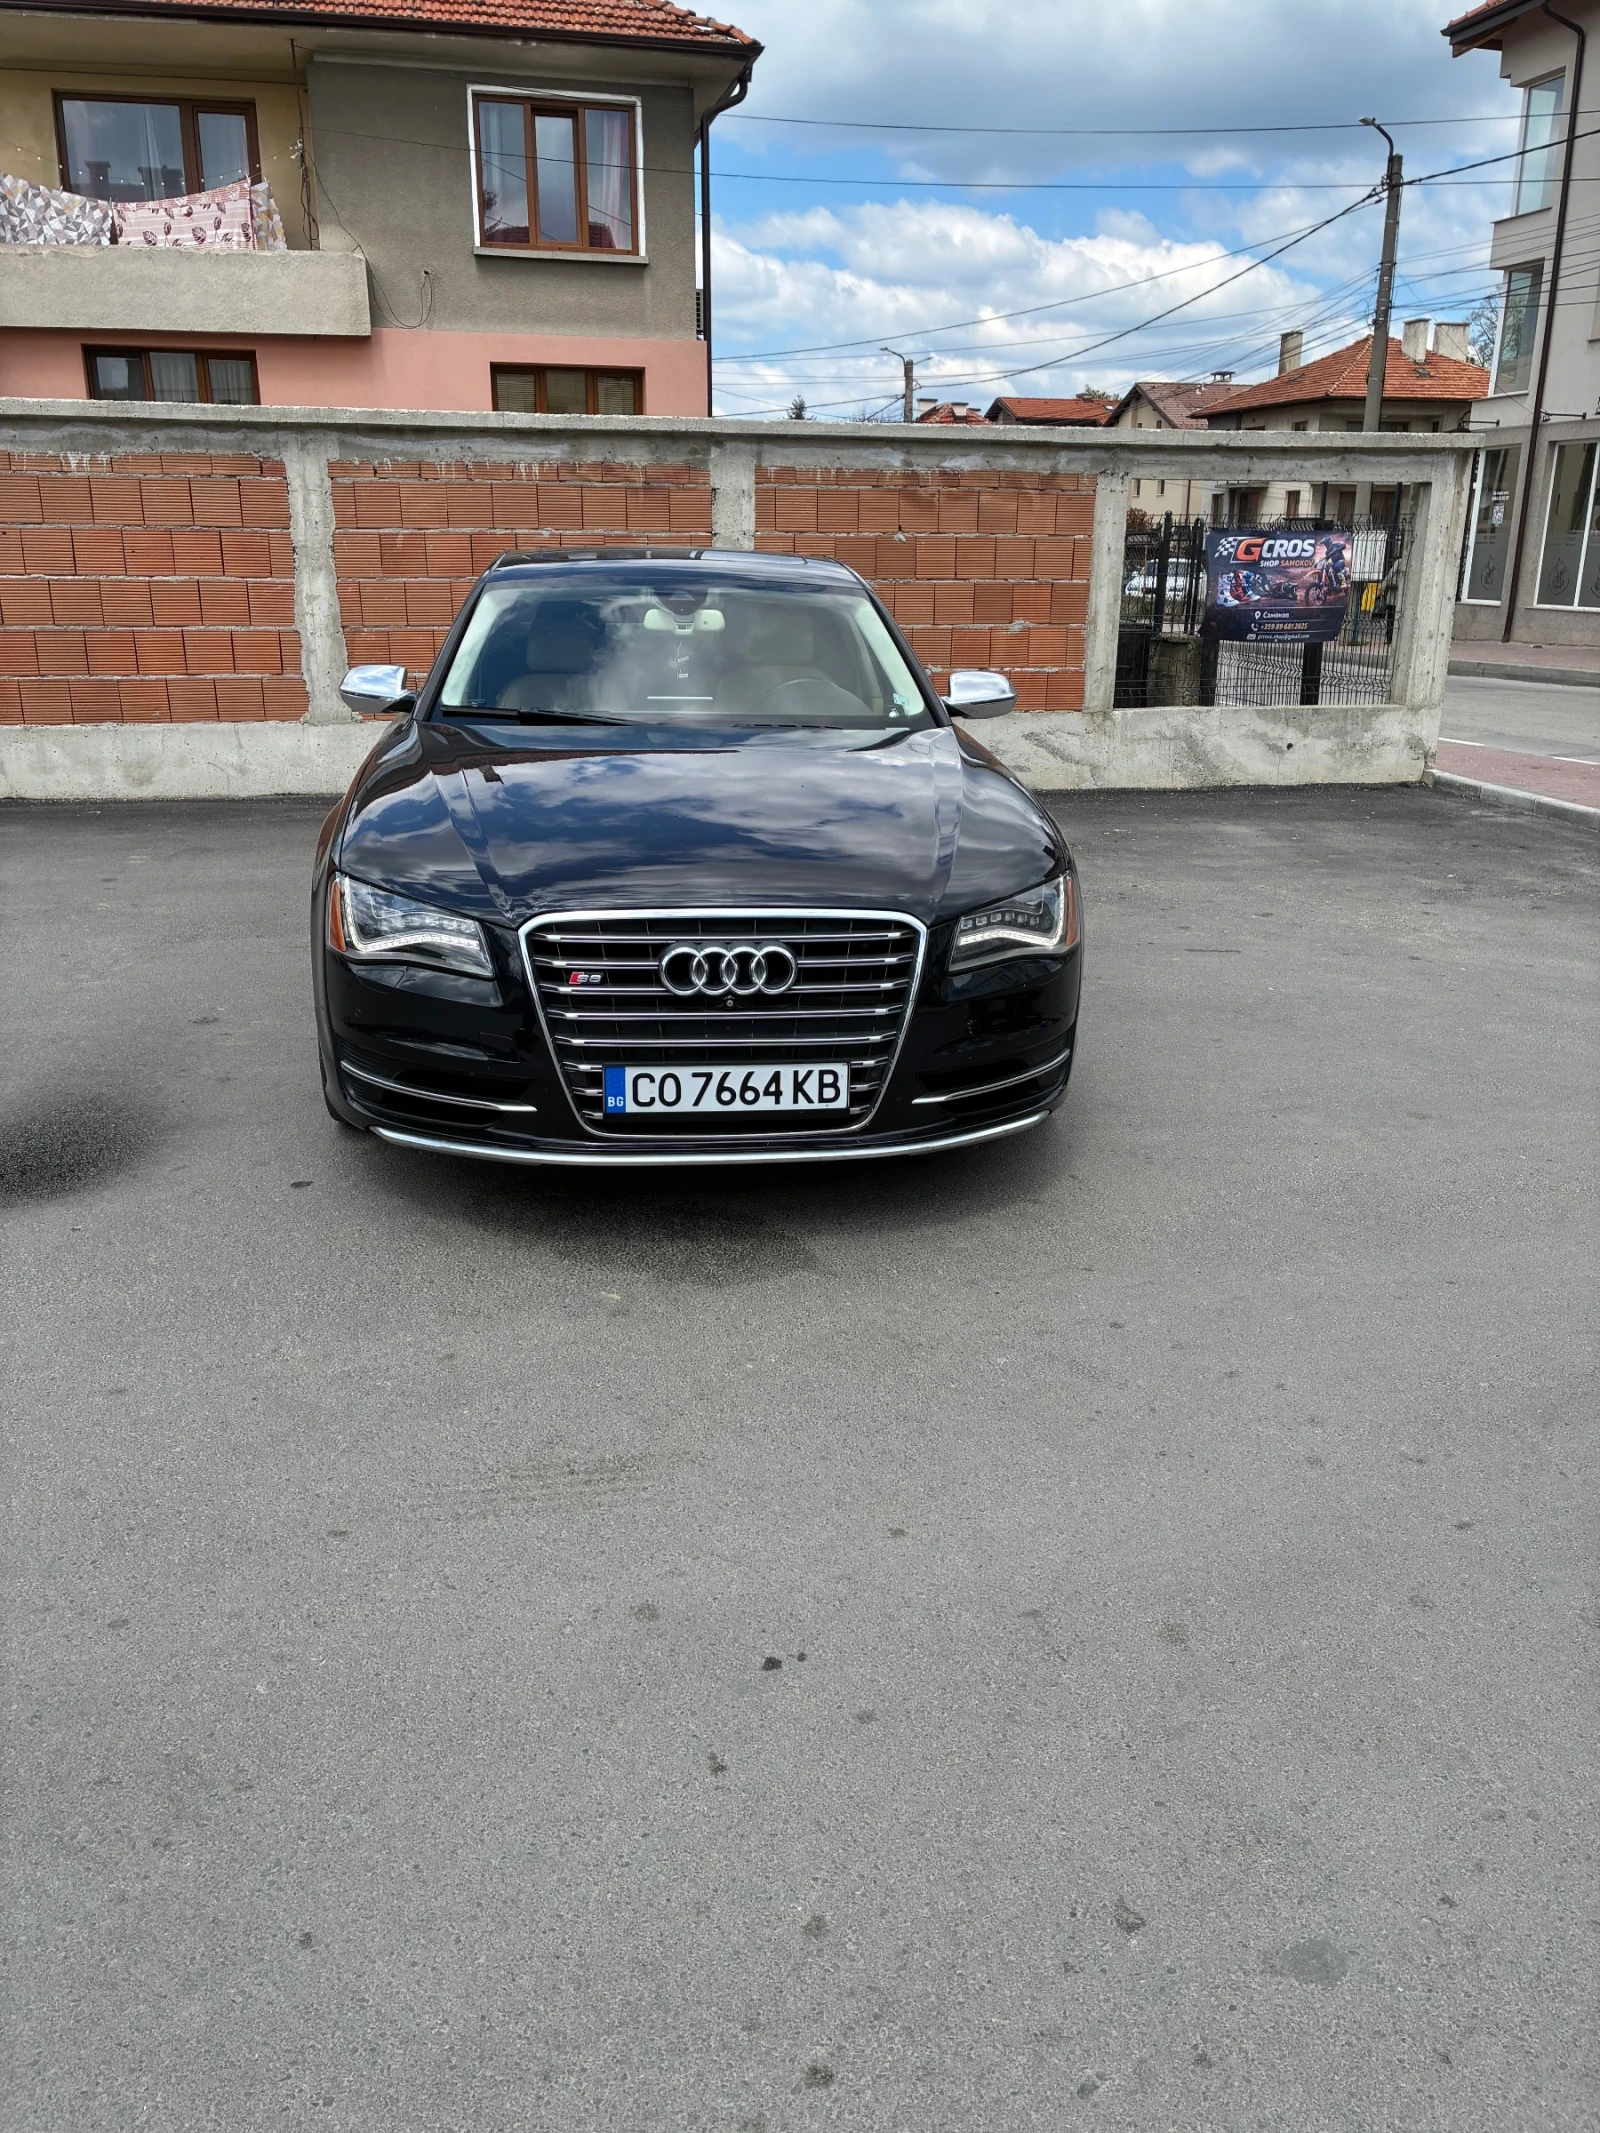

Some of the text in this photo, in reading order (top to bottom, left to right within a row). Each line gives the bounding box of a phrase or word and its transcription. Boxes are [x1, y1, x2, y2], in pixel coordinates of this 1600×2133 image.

[1236, 537, 1315, 561] GCROS
[691, 1070, 783, 1107] 7664
[607, 1096, 624, 1107] BG
